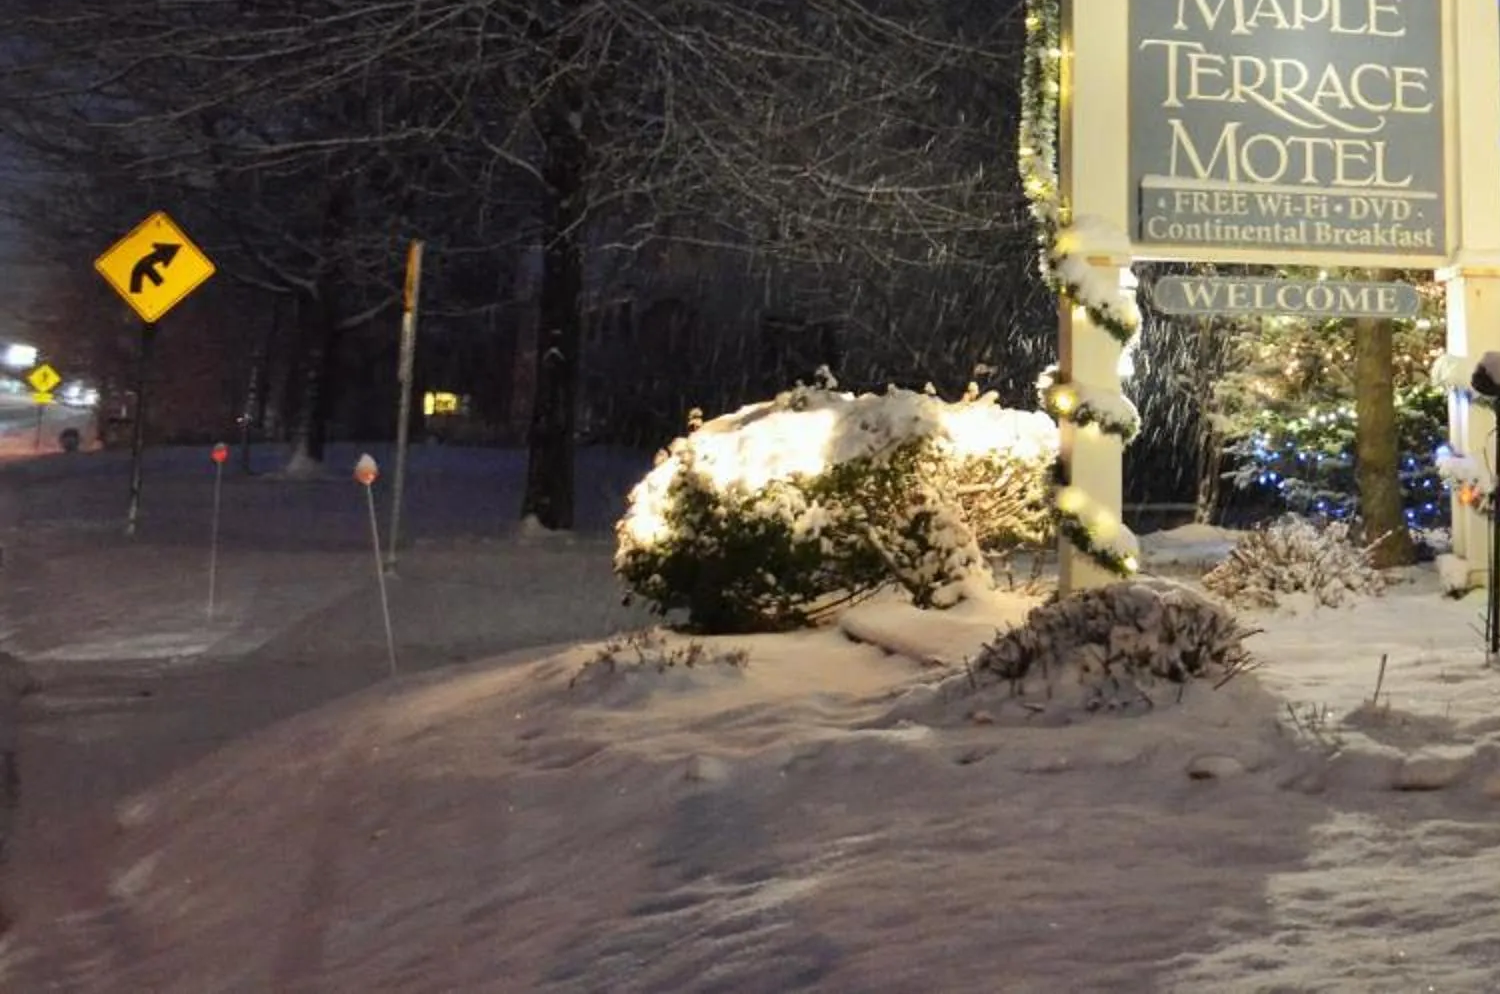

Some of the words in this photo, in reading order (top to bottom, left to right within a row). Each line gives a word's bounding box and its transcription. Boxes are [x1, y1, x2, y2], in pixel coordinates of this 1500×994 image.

[1138, 39, 1435, 134] TERRACE
[1167, 119, 1412, 188] MOTEL
[1174, 190, 1249, 215] FREE
[1255, 193, 1328, 218] Wi-Fi
[1349, 197, 1411, 221] DVD
[1147, 215, 1308, 244] Continental
[1315, 220, 1435, 248] Breakfast
[1180, 281, 1400, 313] WELCOME
